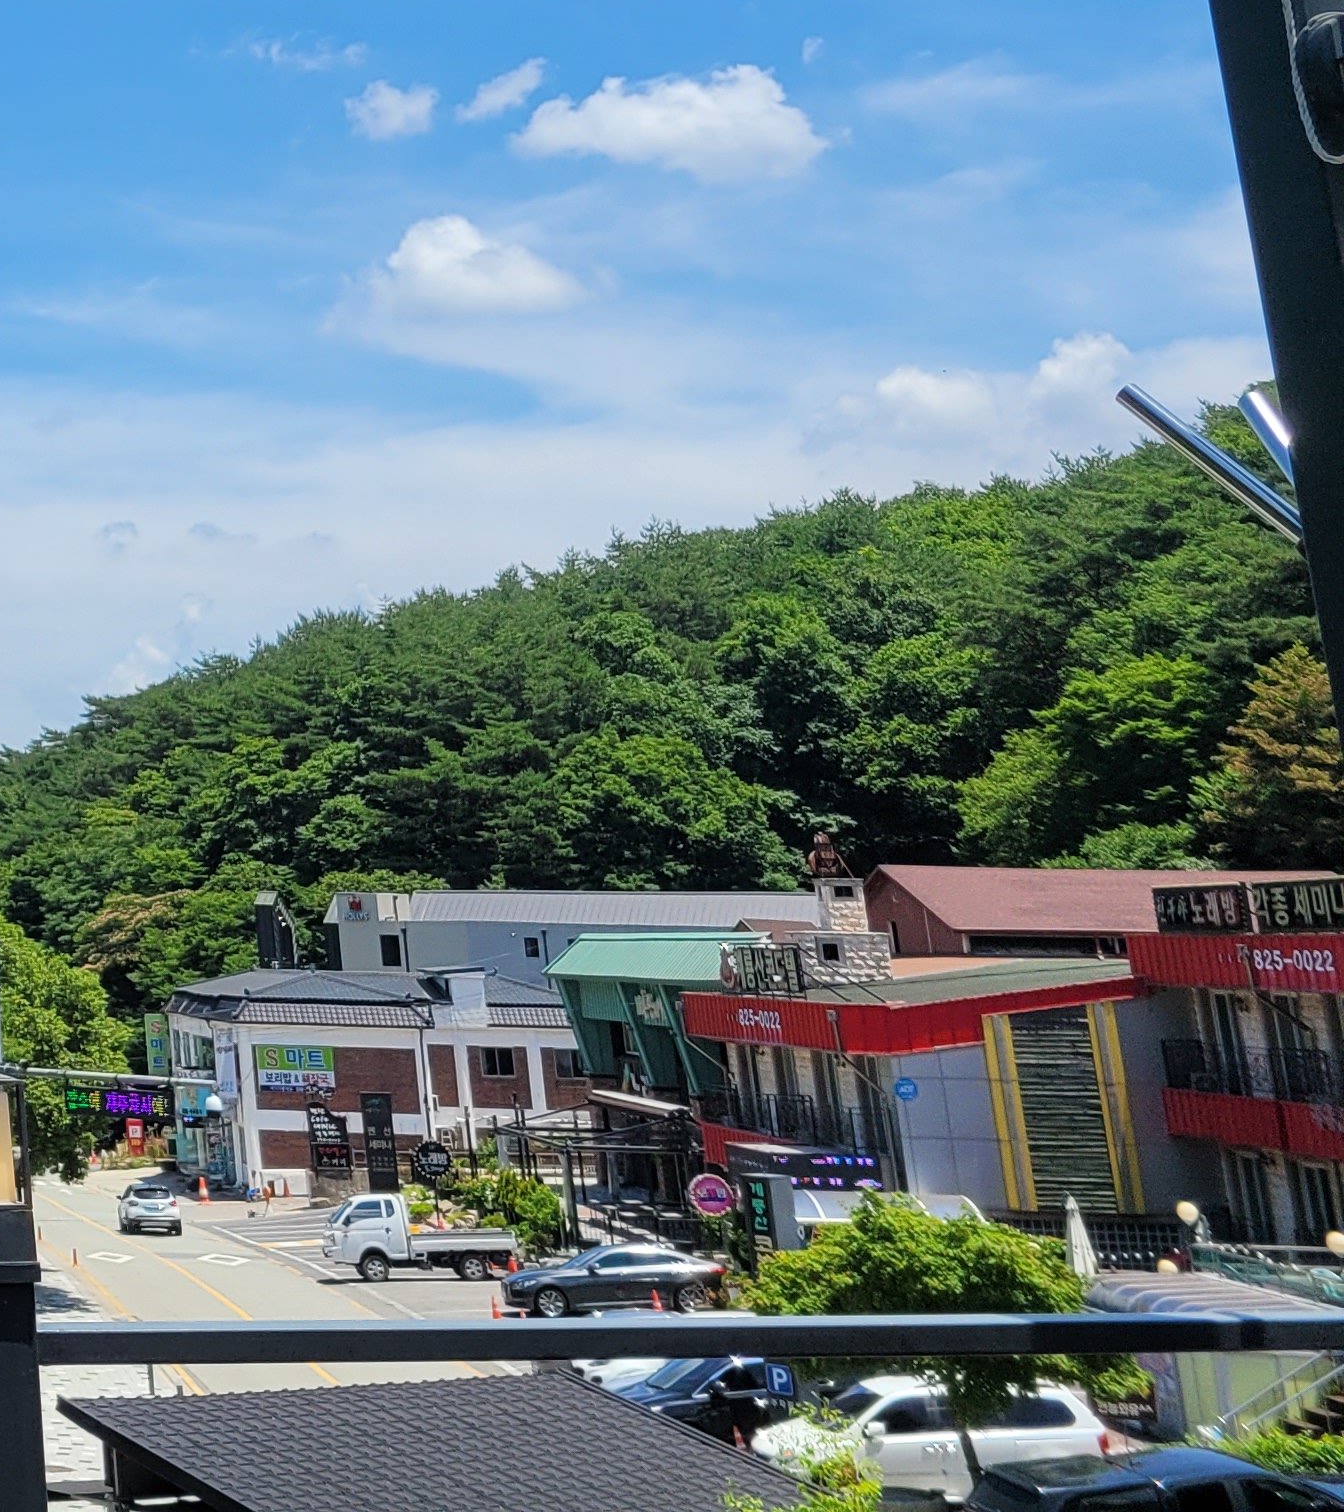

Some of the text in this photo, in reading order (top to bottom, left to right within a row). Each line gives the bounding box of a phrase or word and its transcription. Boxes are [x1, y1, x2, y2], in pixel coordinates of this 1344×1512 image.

[1188, 890, 1237, 926] 노래방
[1253, 949, 1335, 972] 825-0022
[738, 1008, 782, 1029] 825-0022
[284, 1048, 325, 1069] 마트
[265, 1071, 292, 1084] 보리밥
[418, 1151, 448, 1165] 노래방
[772, 1368, 788, 1391] P
